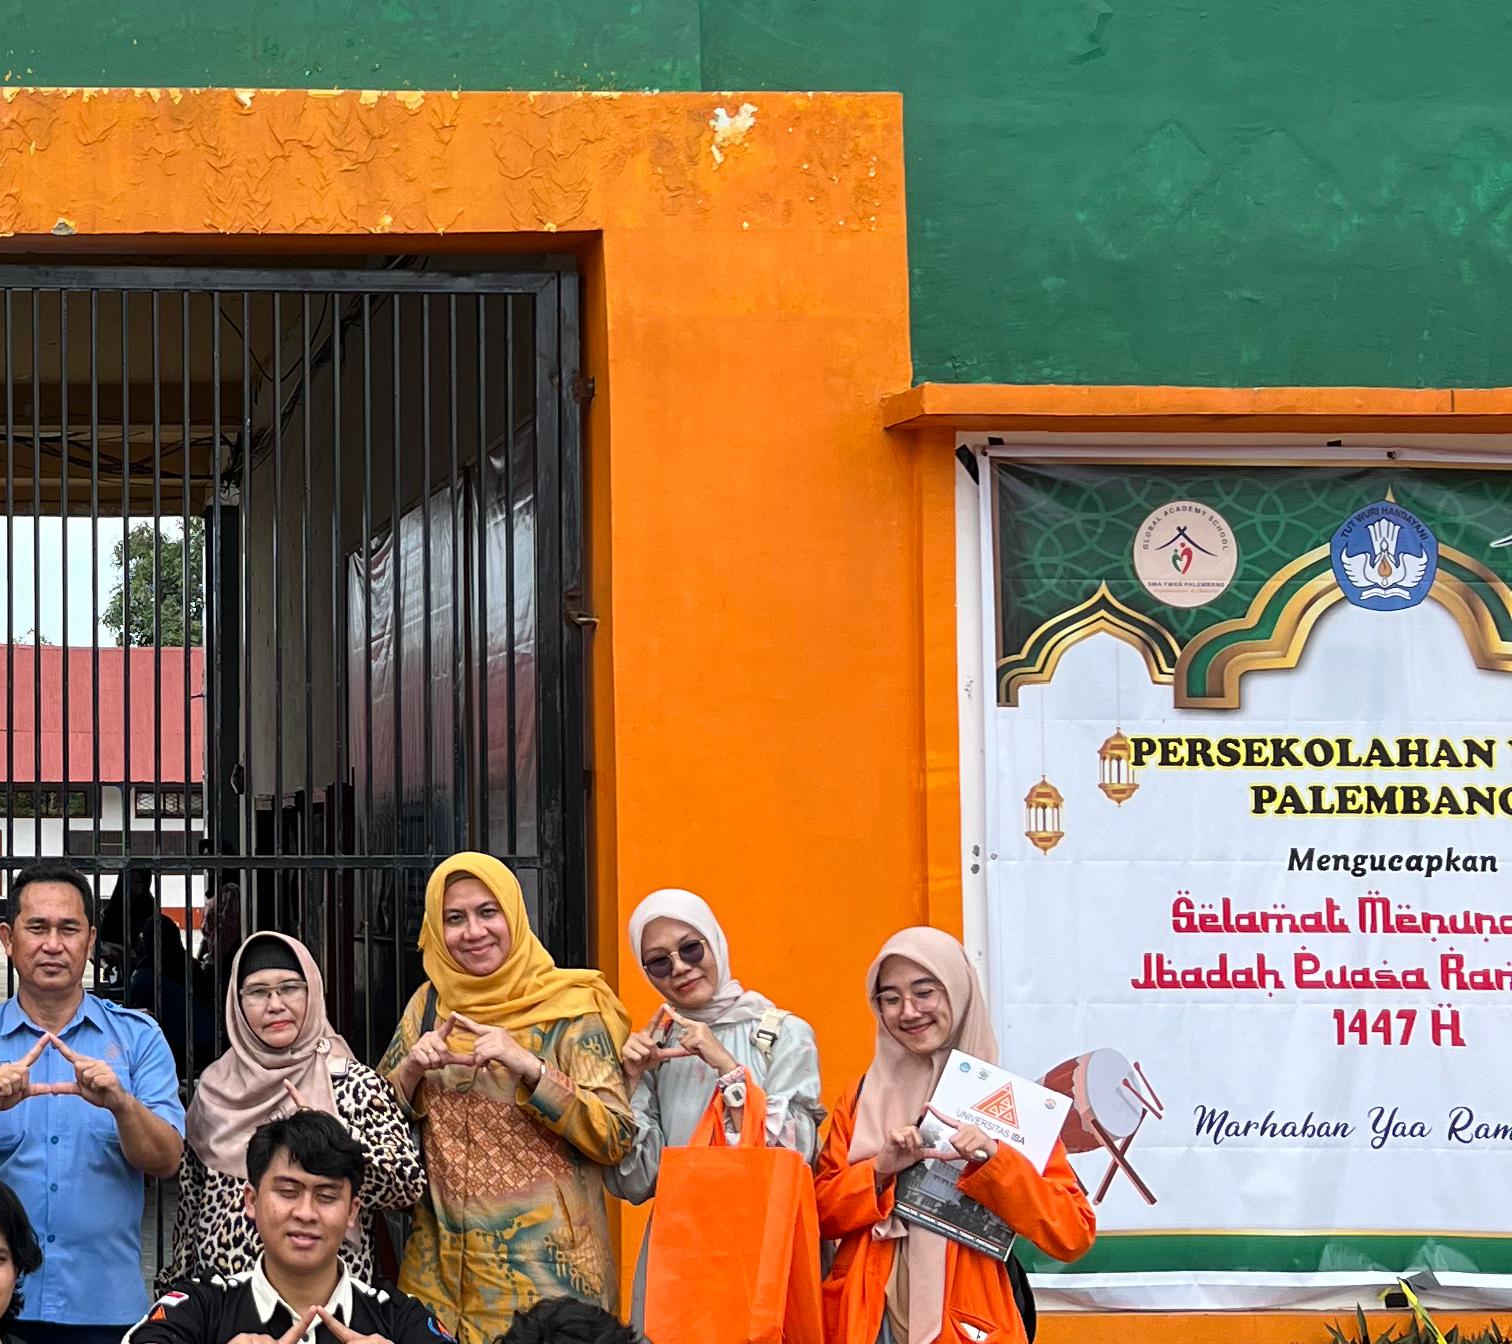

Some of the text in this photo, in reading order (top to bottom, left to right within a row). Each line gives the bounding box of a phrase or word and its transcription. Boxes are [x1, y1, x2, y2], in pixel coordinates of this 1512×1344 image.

[1142, 505, 1229, 552] GLOBAL ACADEMY SCHOOL
[1340, 506, 1429, 541] TUT WURI HANDAYANI
[1129, 737, 1497, 769] PERSEKOLAHAN
[1287, 846, 1499, 878] Mengucapkan
[1171, 890, 1352, 934] Selamat
[1293, 946, 1433, 990] Puasa
[1332, 1002, 1468, 1047] 1447 H
[955, 1108, 1026, 1146] UNIVERSITAS IBA
[1193, 1104, 1357, 1145] Marhaban
[1367, 1105, 1434, 1150] Yaa
